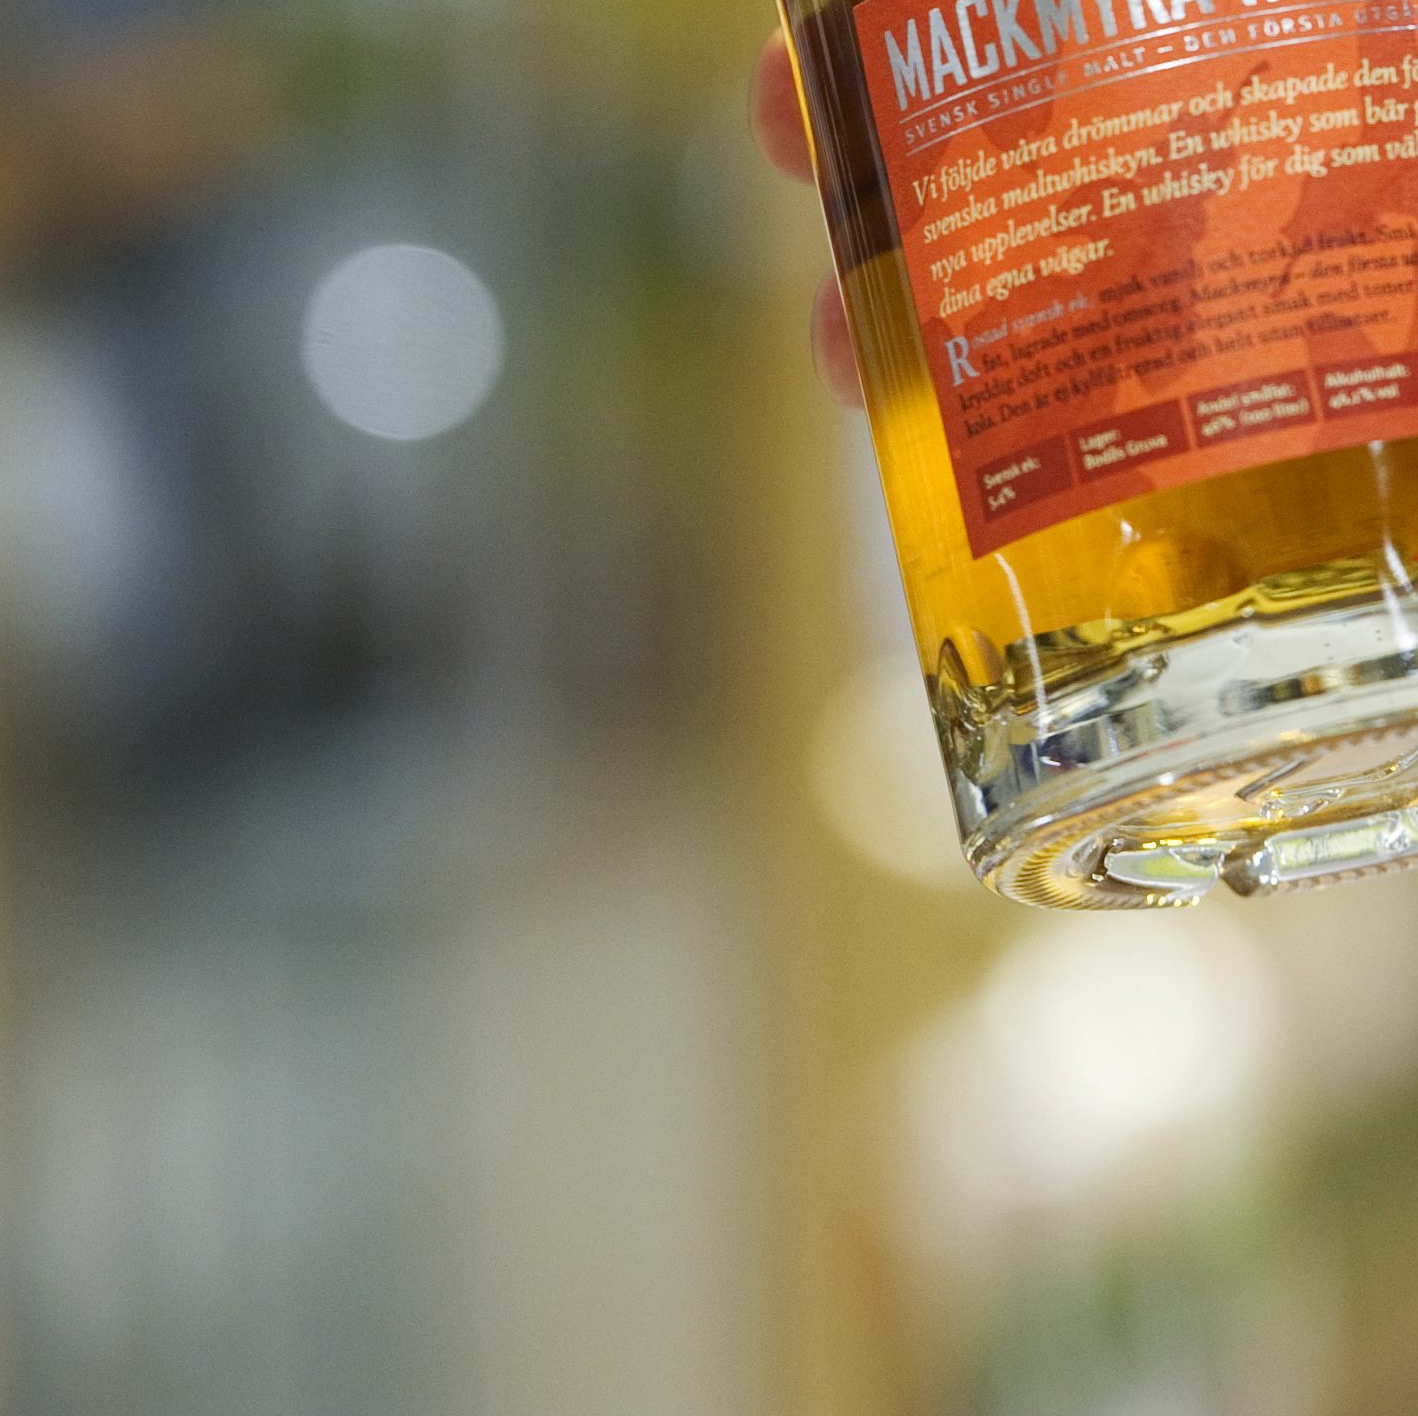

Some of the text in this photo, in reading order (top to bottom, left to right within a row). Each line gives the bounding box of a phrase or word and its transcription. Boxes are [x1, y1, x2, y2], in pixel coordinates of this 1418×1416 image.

[904, 100, 979, 144] SVENSK
[987, 70, 1068, 108] SINGLE
[1083, 46, 1145, 77] MALT
[1184, 28, 1237, 53] DEN
[912, 175, 937, 207] Vi
[939, 150, 997, 202] följde
[1000, 135, 1057, 169] våra
[1062, 101, 1184, 149] drömmar
[1188, 81, 1233, 116] och
[1240, 62, 1349, 106] skapade
[1353, 57, 1399, 88] den
[923, 194, 997, 244] svenska
[1001, 146, 1163, 209] maltwhiskyn.
[1169, 130, 1205, 161] En
[1210, 109, 1302, 150] whisky
[1308, 107, 1361, 133] som
[1364, 95, 1410, 125] bär
[930, 249, 967, 283] nya
[970, 203, 1097, 265] upplevelser.
[1101, 187, 1137, 218] En
[1142, 162, 1235, 206] whisky
[1237, 153, 1278, 192] för
[1284, 144, 1328, 178] dig
[1331, 143, 1381, 168] som
[938, 238, 1115, 319] dina egna vägar.
